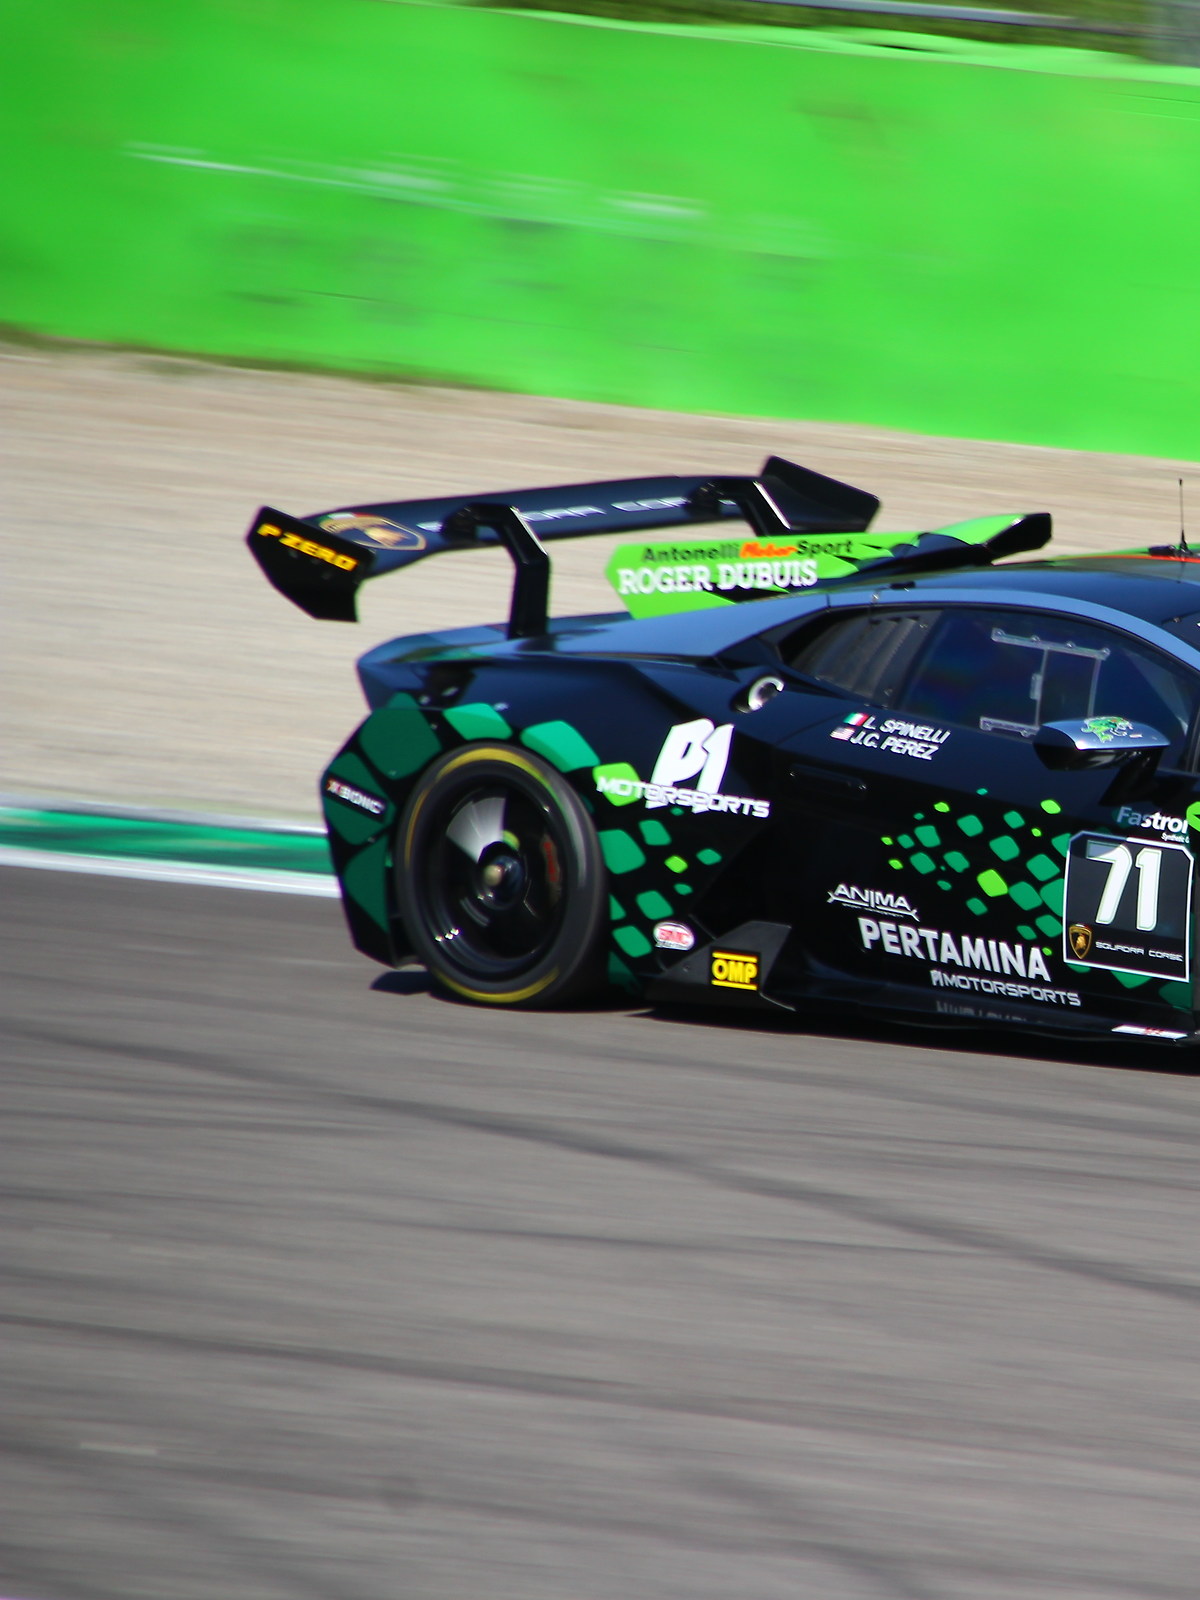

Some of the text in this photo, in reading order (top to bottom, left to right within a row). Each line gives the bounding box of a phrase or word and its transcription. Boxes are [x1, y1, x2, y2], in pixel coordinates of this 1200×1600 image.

[257, 523, 359, 572] P ZERO
[642, 545, 739, 562] Antonelli
[796, 539, 853, 559] Sport
[616, 560, 819, 595] ROGER DUBUIS
[880, 718, 951, 744] SPINELLI
[880, 735, 939, 760] PEREZ
[646, 717, 735, 814] P1
[596, 776, 771, 818] MOTORSPORTS
[834, 883, 911, 911] ANIMA
[1086, 839, 1163, 932] 71
[857, 917, 1052, 982] PERTAMINA
[711, 958, 758, 984] OMP
[943, 973, 1082, 1007] MOTORSPORTS
